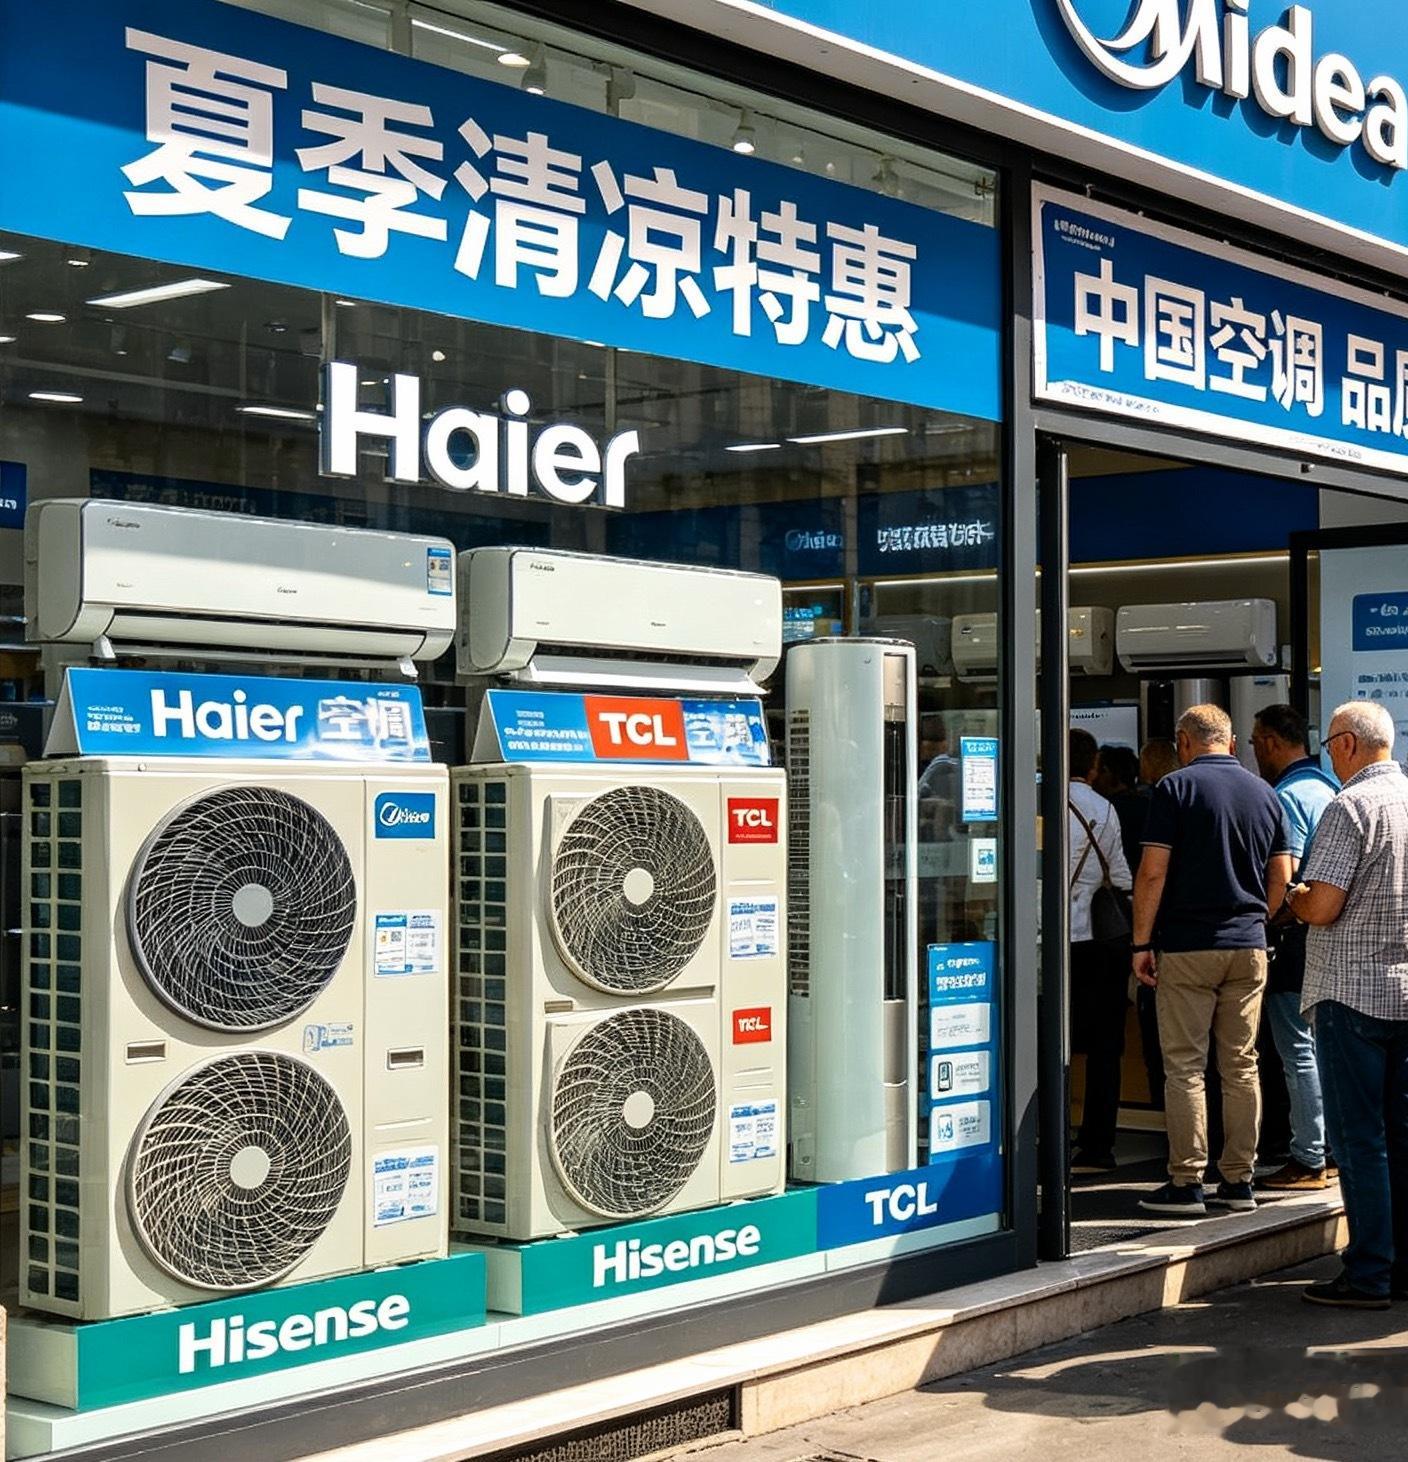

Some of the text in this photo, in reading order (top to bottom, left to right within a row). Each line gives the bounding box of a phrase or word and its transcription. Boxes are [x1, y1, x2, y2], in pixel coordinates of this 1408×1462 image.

[1058, 0, 1408, 170] Midea
[120, 26, 920, 364] 夏季清凉特惠
[1074, 257, 1325, 419] 中国空调
[319, 360, 640, 508] Haier
[150, 688, 304, 743] Haier
[317, 696, 417, 746] 空调
[598, 714, 677, 747] TCL
[732, 808, 773, 827] TCL
[865, 1183, 938, 1226] TCL
[593, 1223, 761, 1288] Hisense
[178, 1293, 411, 1375] Hisense
